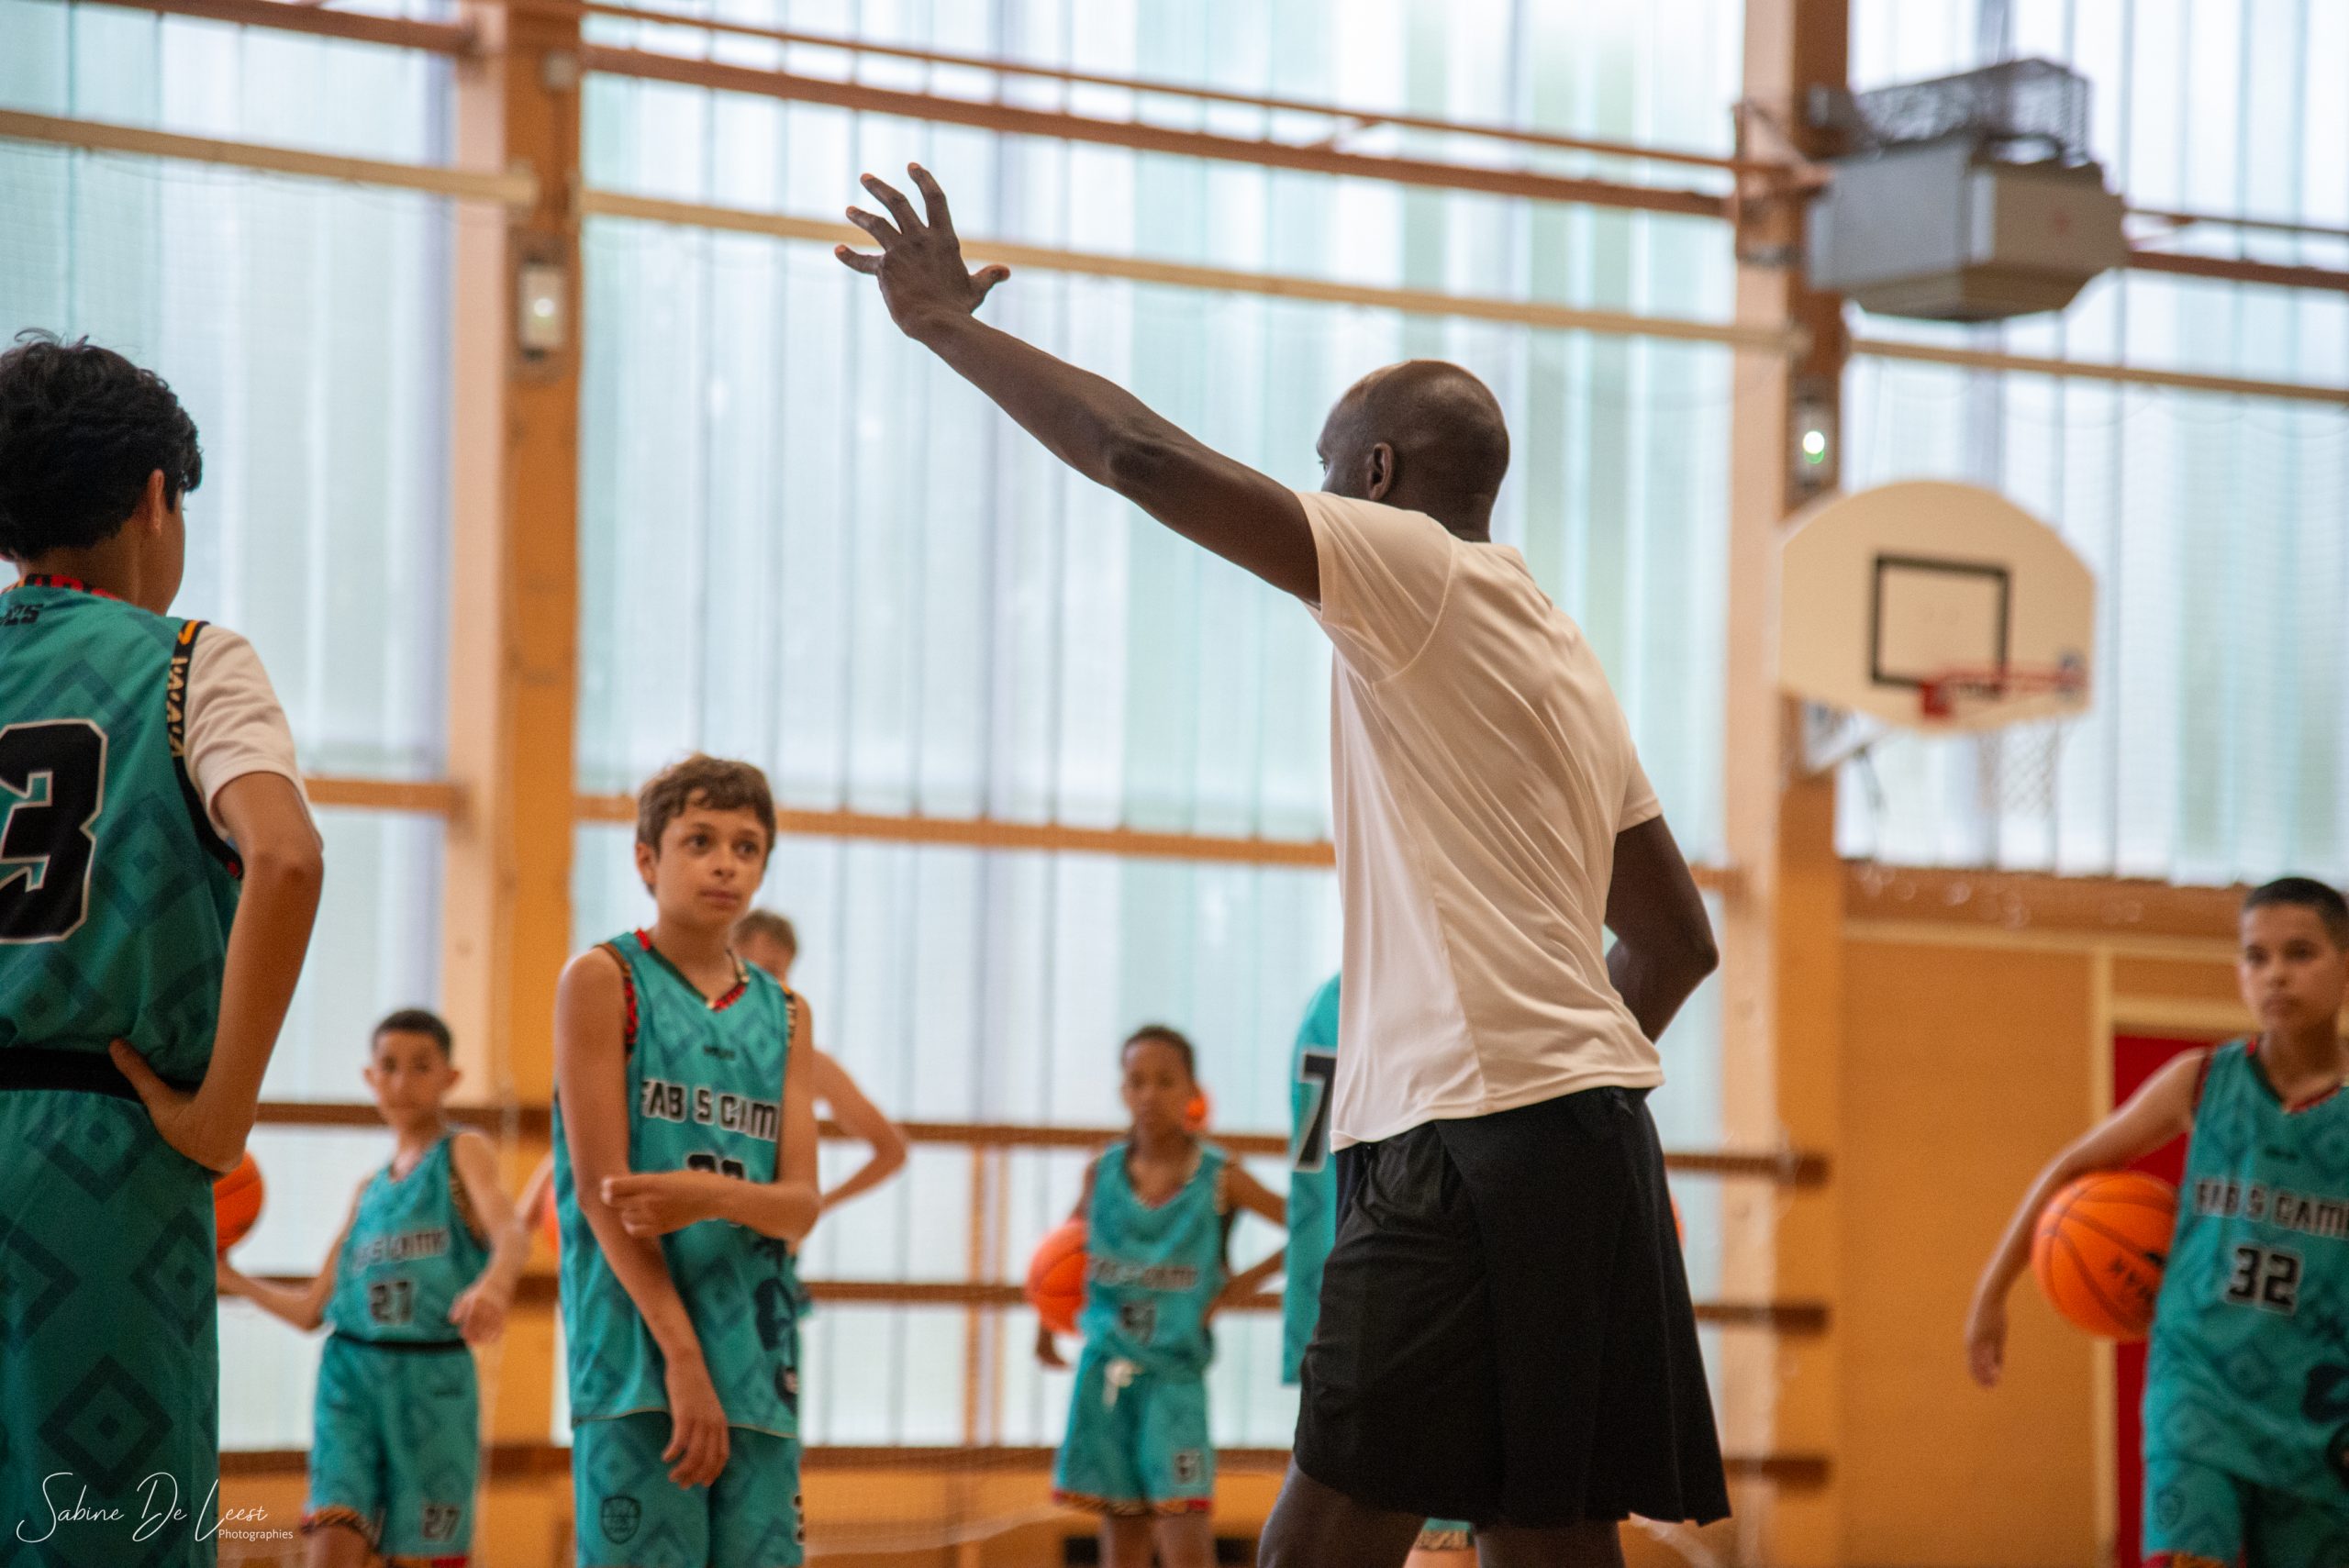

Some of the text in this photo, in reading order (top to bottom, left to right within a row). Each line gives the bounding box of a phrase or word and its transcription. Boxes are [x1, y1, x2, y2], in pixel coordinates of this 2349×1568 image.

[0, 718, 107, 943] 3
[694, 1086, 715, 1126] S
[1295, 1047, 1338, 1173] 7
[2225, 1245, 2303, 1315] 32
